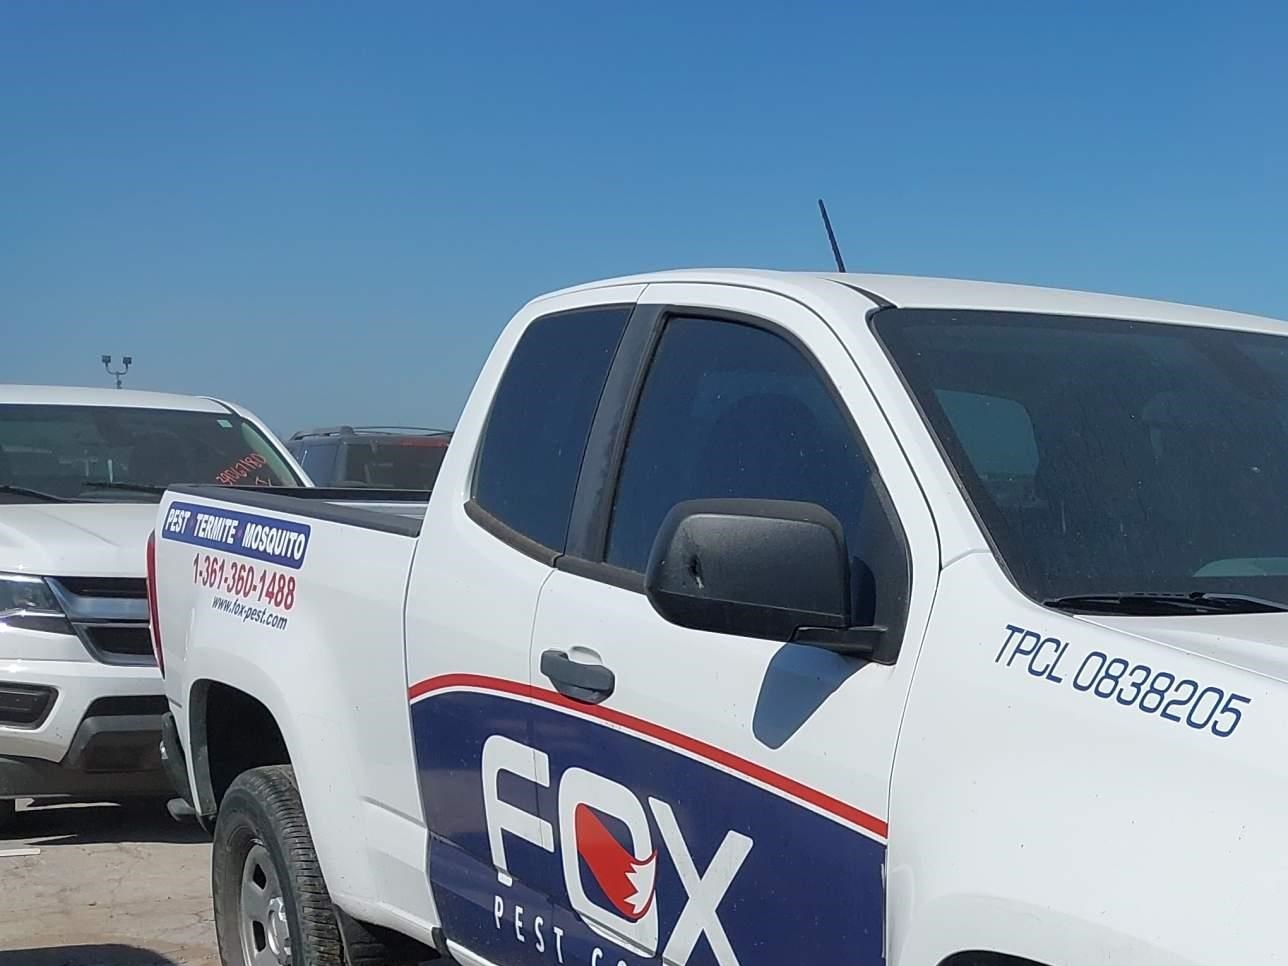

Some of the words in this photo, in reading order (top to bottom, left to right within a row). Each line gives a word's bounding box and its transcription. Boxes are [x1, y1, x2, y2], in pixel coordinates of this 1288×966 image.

[165, 508, 191, 534] PEST
[193, 513, 239, 545] TERMITE
[242, 522, 306, 560] MOSQUITO
[193, 552, 296, 610] 1-361-360-1488
[212, 596, 288, 630] www.fox-pest.com
[995, 624, 1070, 684] TPCL
[1072, 651, 1252, 738] 0838205
[494, 895, 565, 964] PEST
